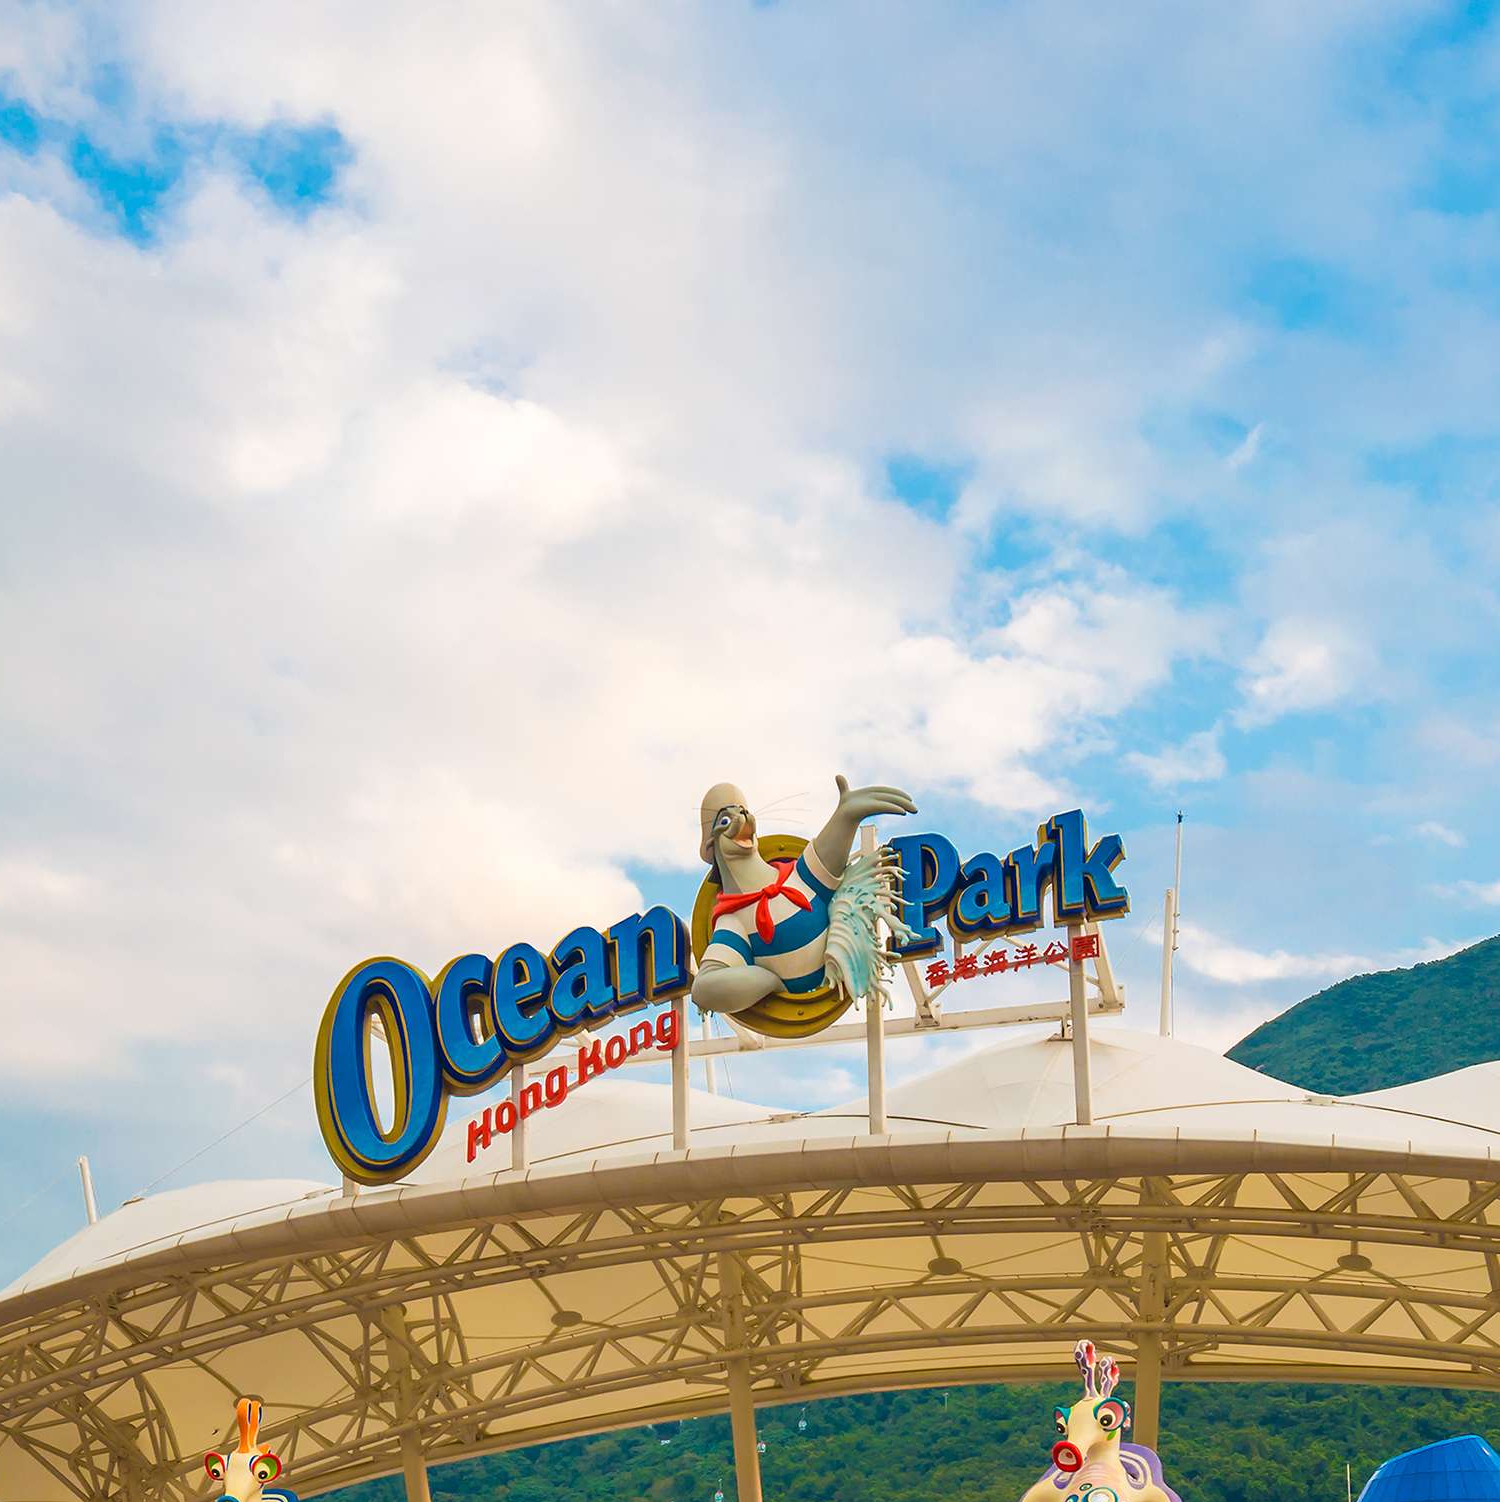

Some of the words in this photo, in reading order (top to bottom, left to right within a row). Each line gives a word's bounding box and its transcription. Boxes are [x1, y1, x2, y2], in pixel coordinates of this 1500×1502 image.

[315, 903, 691, 1185] Ocean
[887, 808, 1131, 963] Park
[925, 934, 1100, 988] 香港海洋公園
[466, 1065, 568, 1163] Hong
[577, 1009, 681, 1086] Kong
